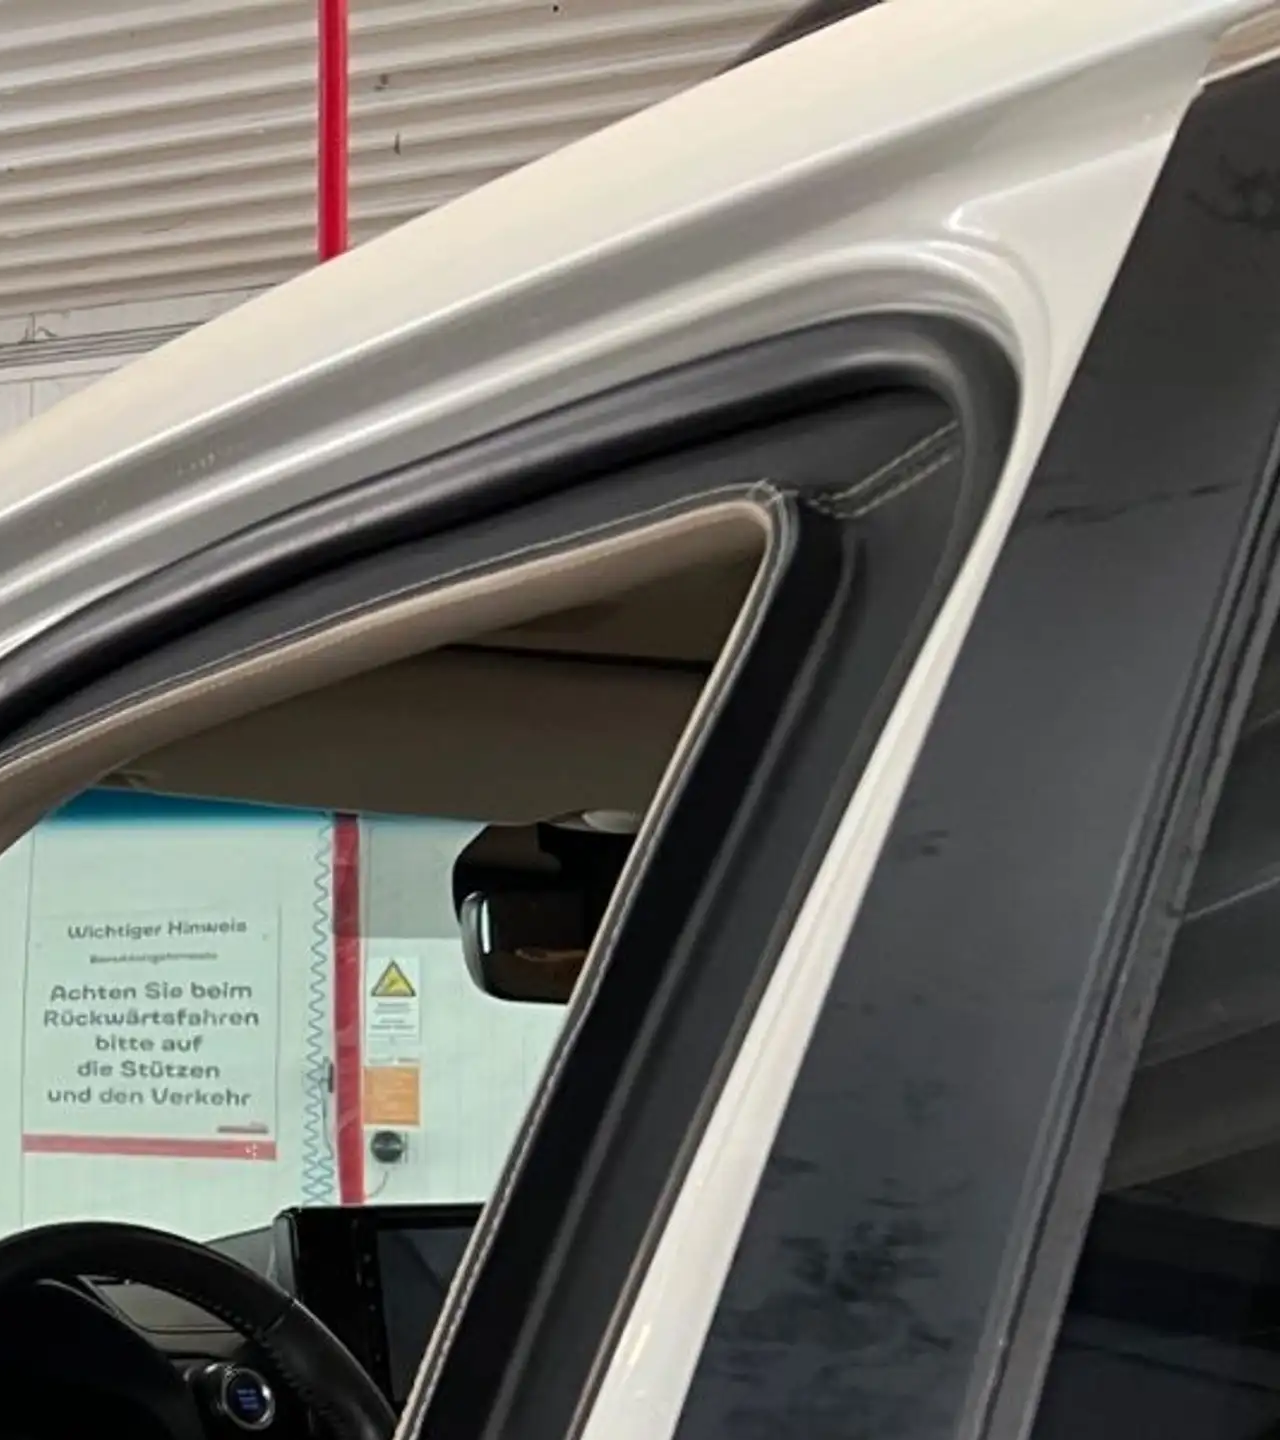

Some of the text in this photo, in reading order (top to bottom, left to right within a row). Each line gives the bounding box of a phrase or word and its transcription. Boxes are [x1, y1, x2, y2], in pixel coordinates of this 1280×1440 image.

[68, 917, 247, 940] Wichtiger Hinweis
[50, 981, 253, 1001] Achten Sie beim
[43, 1008, 260, 1027] Rückwärtsfahren
[96, 1033, 203, 1052] bitte auf
[77, 1060, 221, 1079] die Stützen
[47, 1086, 251, 1106] und den Verkehr
